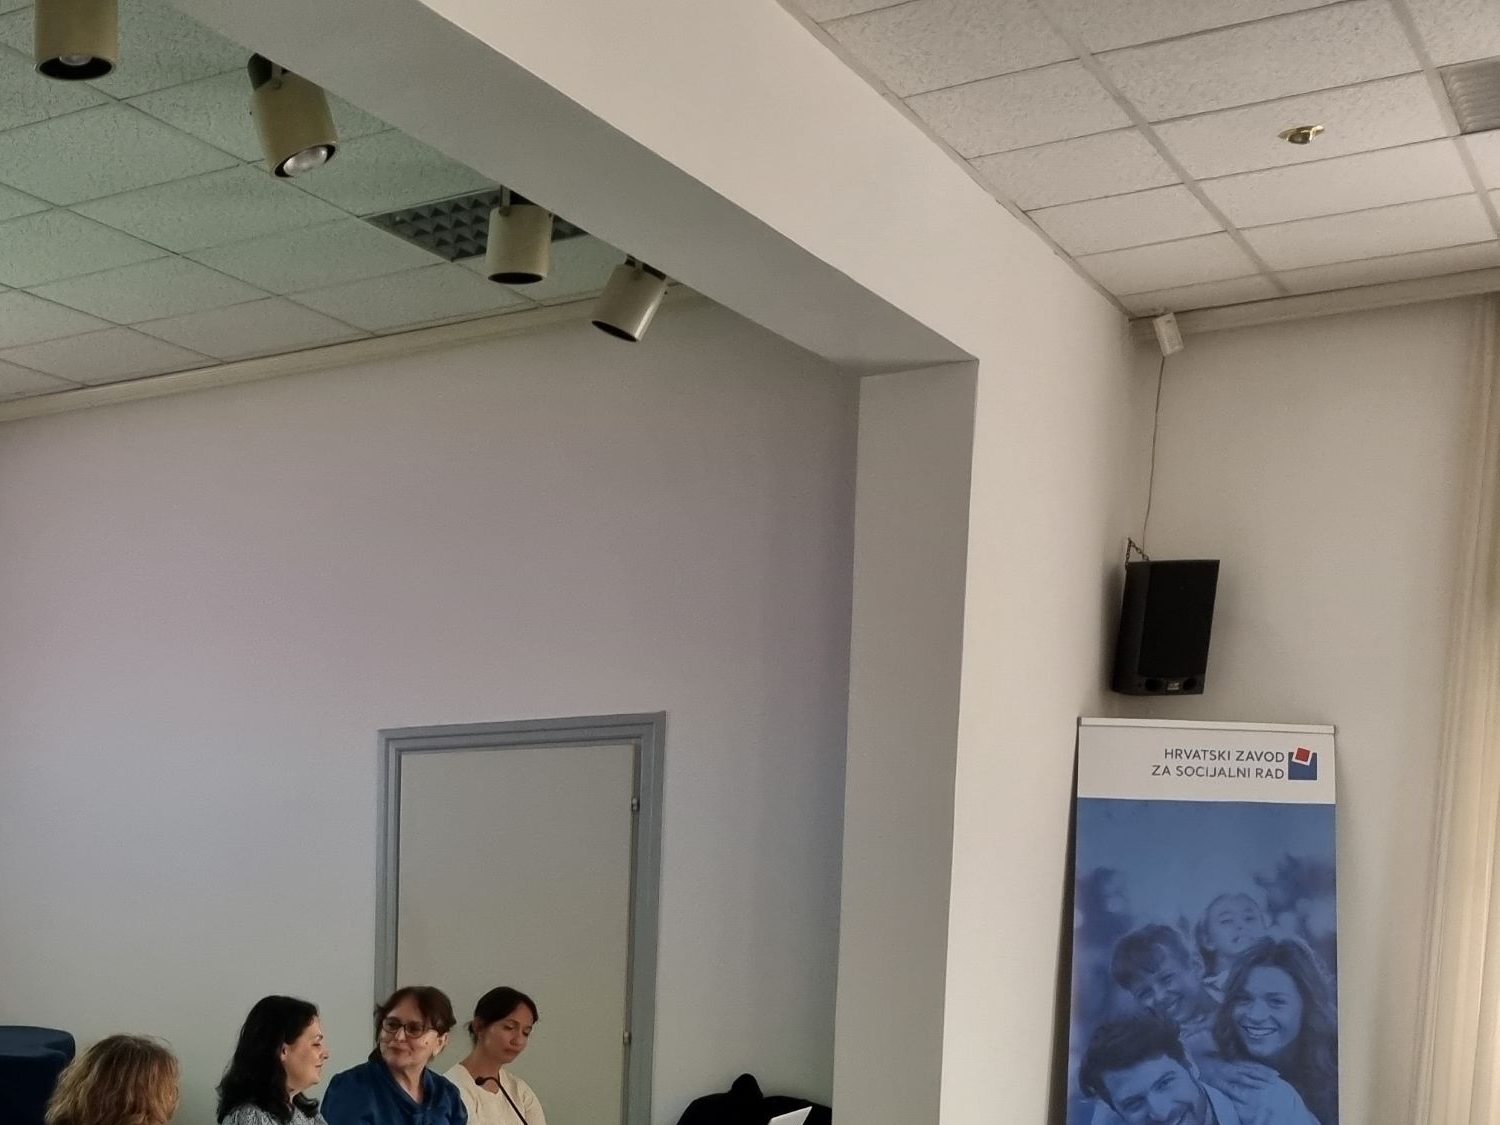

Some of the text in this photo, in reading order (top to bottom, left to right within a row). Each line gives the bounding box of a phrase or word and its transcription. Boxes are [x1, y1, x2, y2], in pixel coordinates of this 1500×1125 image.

[1164, 748, 1285, 763] HRVATSKI ZAVOD
[1151, 764, 1285, 780] ZA SOCIJALNI RAD
